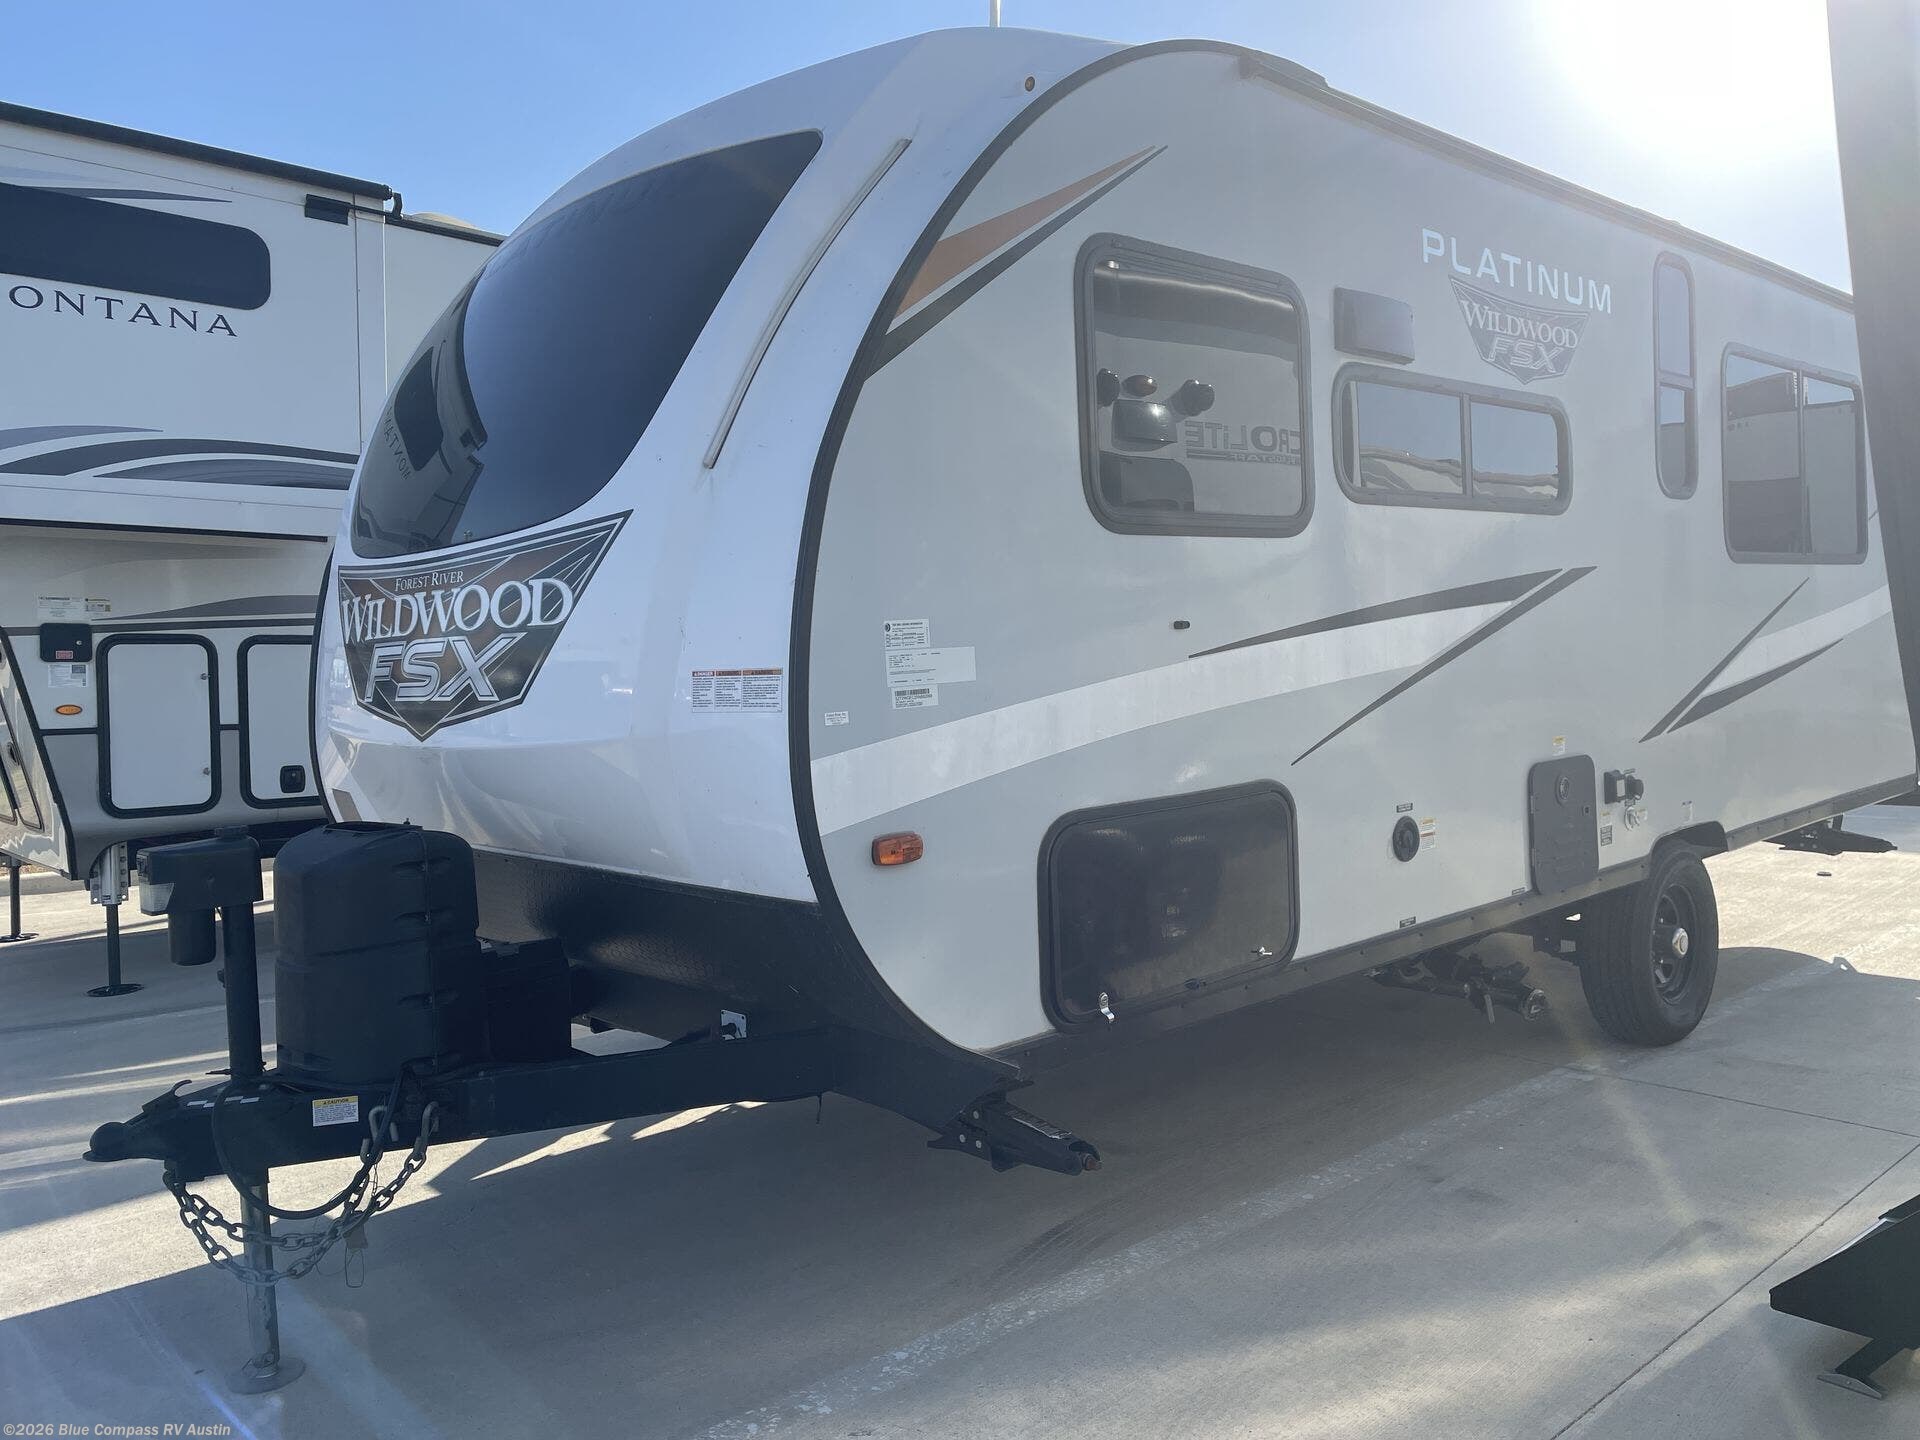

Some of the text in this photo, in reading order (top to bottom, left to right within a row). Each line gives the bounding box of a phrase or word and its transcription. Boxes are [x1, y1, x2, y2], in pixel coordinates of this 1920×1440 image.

[1422, 228, 1612, 315] PLATINUM
[1461, 300, 1578, 349] WILDWOOD
[1487, 335, 1564, 373] FSX
[394, 570, 464, 592] FOREST RIVER
[341, 577, 574, 645] WILDWOOD
[364, 631, 529, 702] FSX
